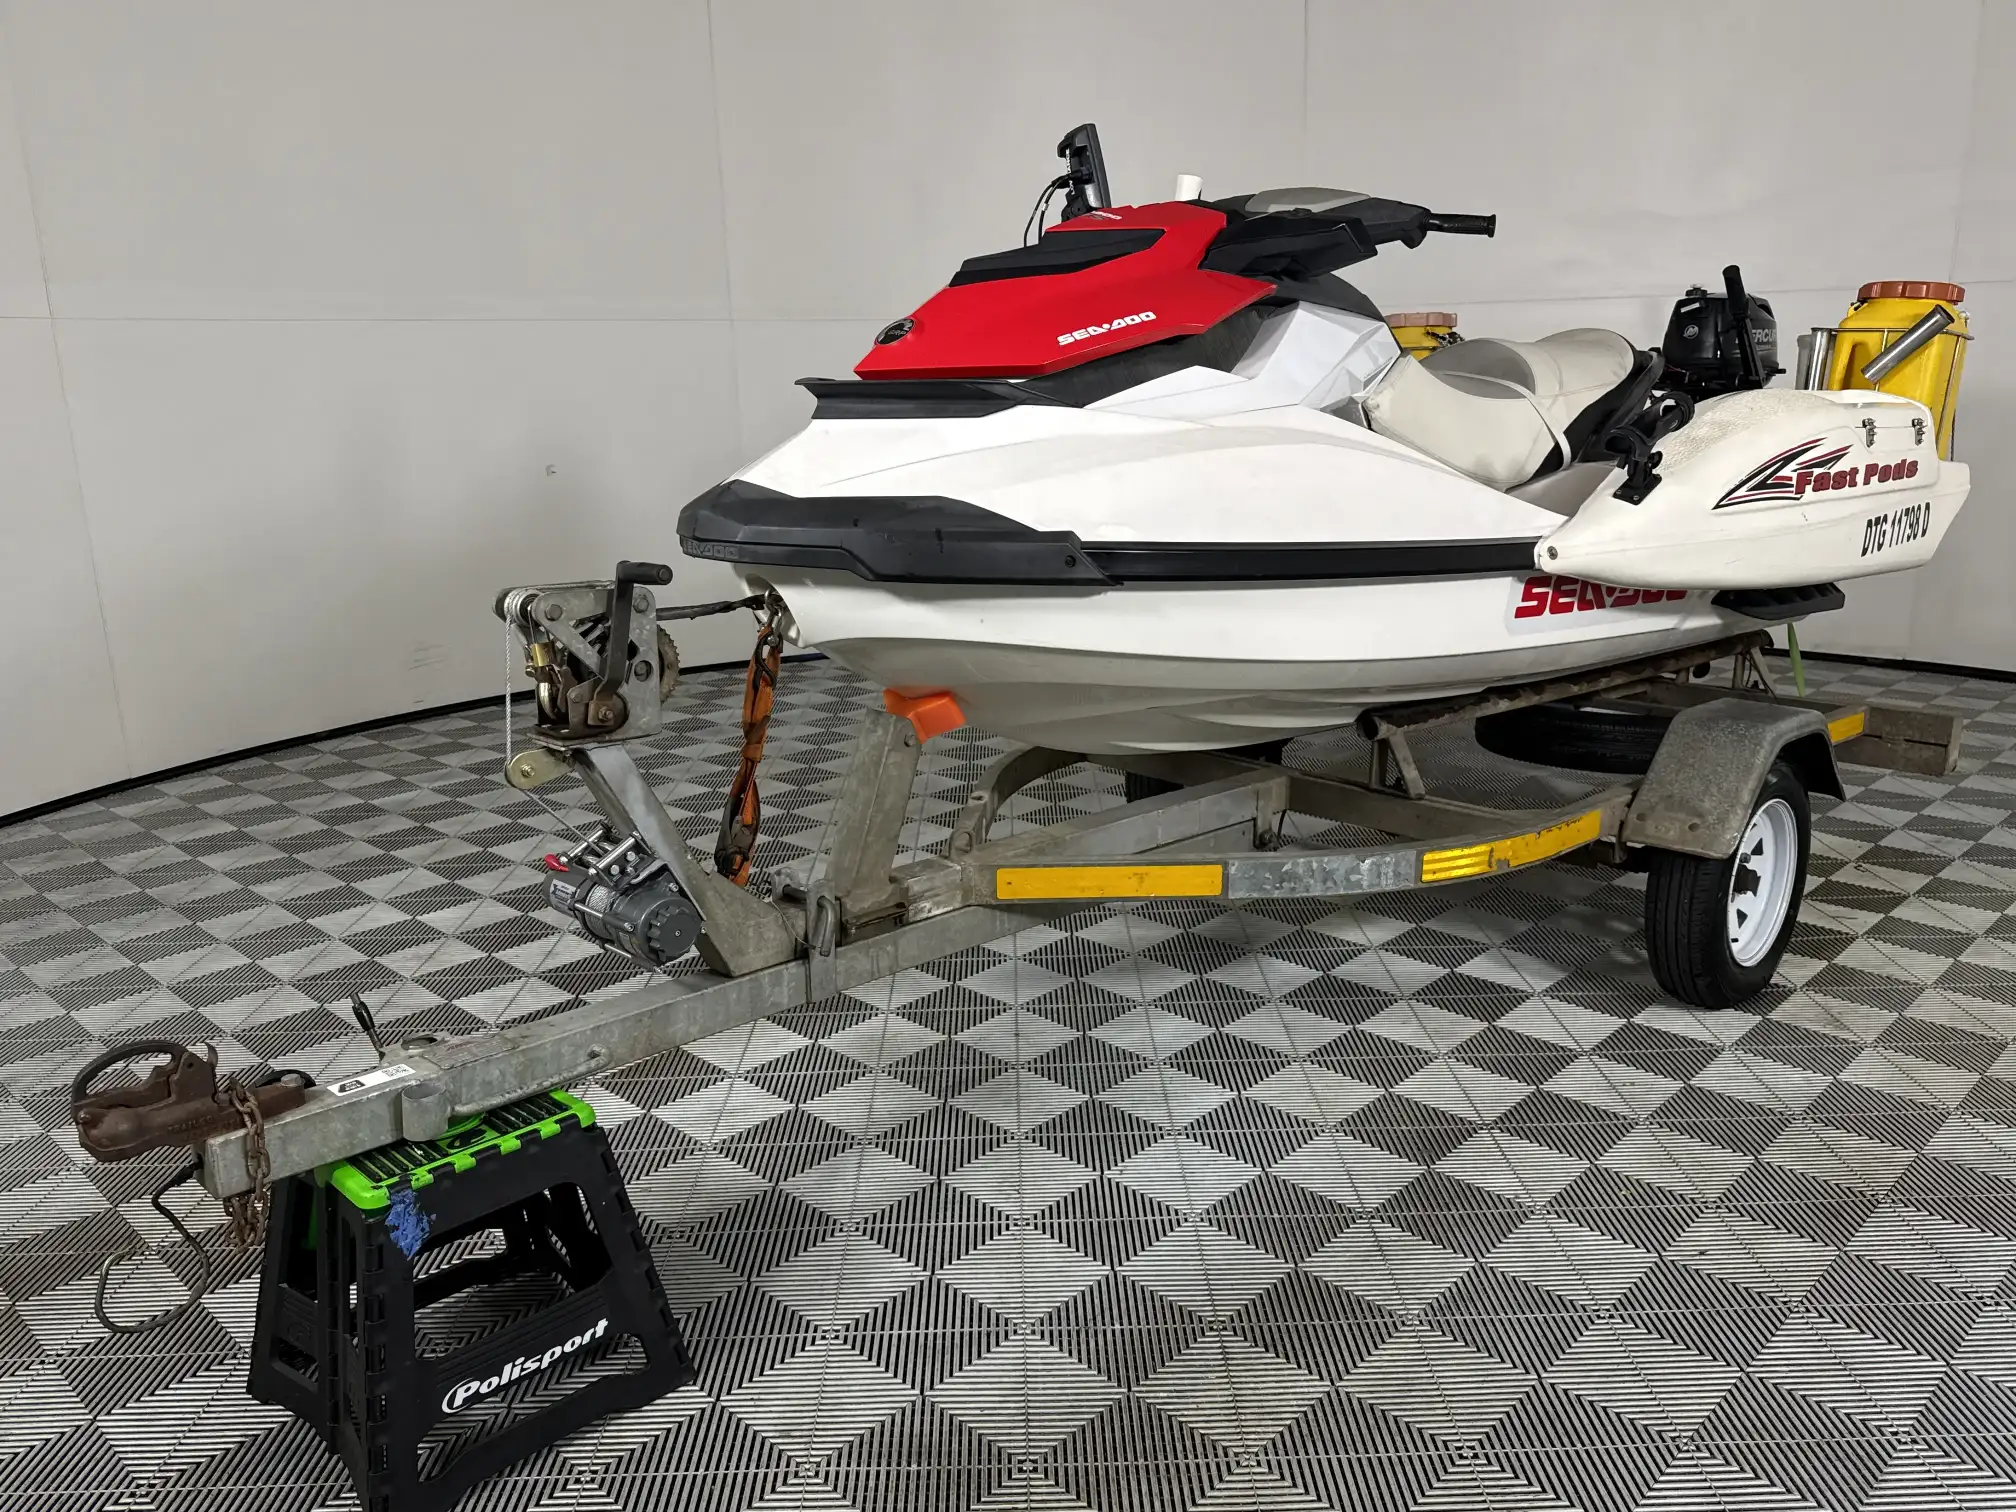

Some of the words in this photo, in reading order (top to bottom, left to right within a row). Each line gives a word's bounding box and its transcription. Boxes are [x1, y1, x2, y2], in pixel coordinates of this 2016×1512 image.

[1794, 466, 1859, 495] Fast
[1862, 458, 1918, 486] Pods
[1861, 513, 1888, 558] DTG
[1888, 503, 1922, 548] 11798
[1920, 501, 1931, 538] D
[452, 1317, 609, 1409] Polisport
